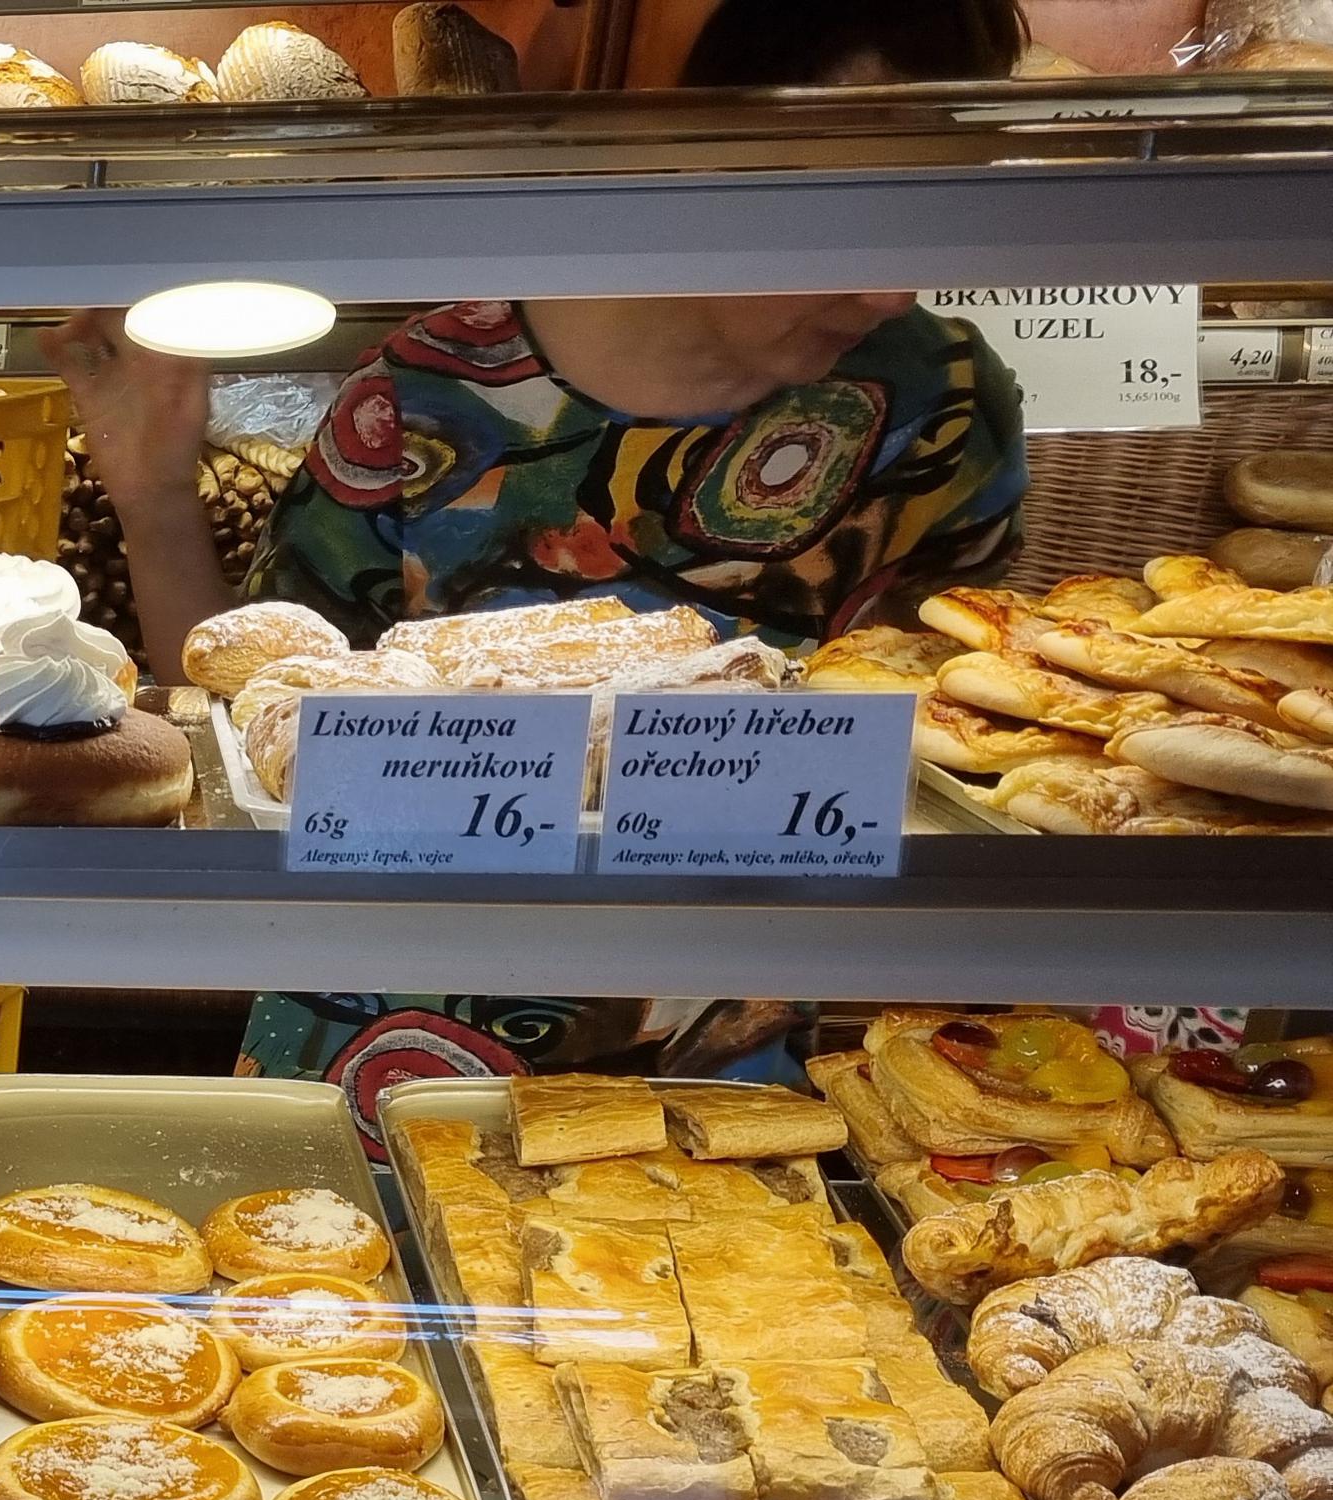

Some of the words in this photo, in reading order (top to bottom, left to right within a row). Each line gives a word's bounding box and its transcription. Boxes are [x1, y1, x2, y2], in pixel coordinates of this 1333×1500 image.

[1014, 318, 1105, 340] UZEL
[1229, 348, 1273, 368] 4,20
[1120, 358, 1182, 388] 18,-
[1118, 392, 1180, 402] 15,65/100g
[311, 710, 421, 736] Listová
[428, 710, 517, 744] kapsa
[625, 708, 736, 742] Listový
[743, 708, 855, 736] hřeben
[382, 752, 555, 778] meruňková
[621, 750, 760, 784] ořechový
[305, 812, 349, 840] 65g
[459, 793, 555, 847] 16,-
[616, 811, 662, 840] 60g
[777, 790, 877, 846] 16,-
[300, 850, 369, 866] Alergeny:
[373, 850, 413, 866] lepek,
[418, 851, 453, 866] vejce
[613, 850, 683, 866] Alergeny:
[687, 850, 729, 866] lepek,
[735, 852, 775, 866] vejce,
[779, 850, 829, 866] mléko,
[833, 851, 885, 867] ořechy
